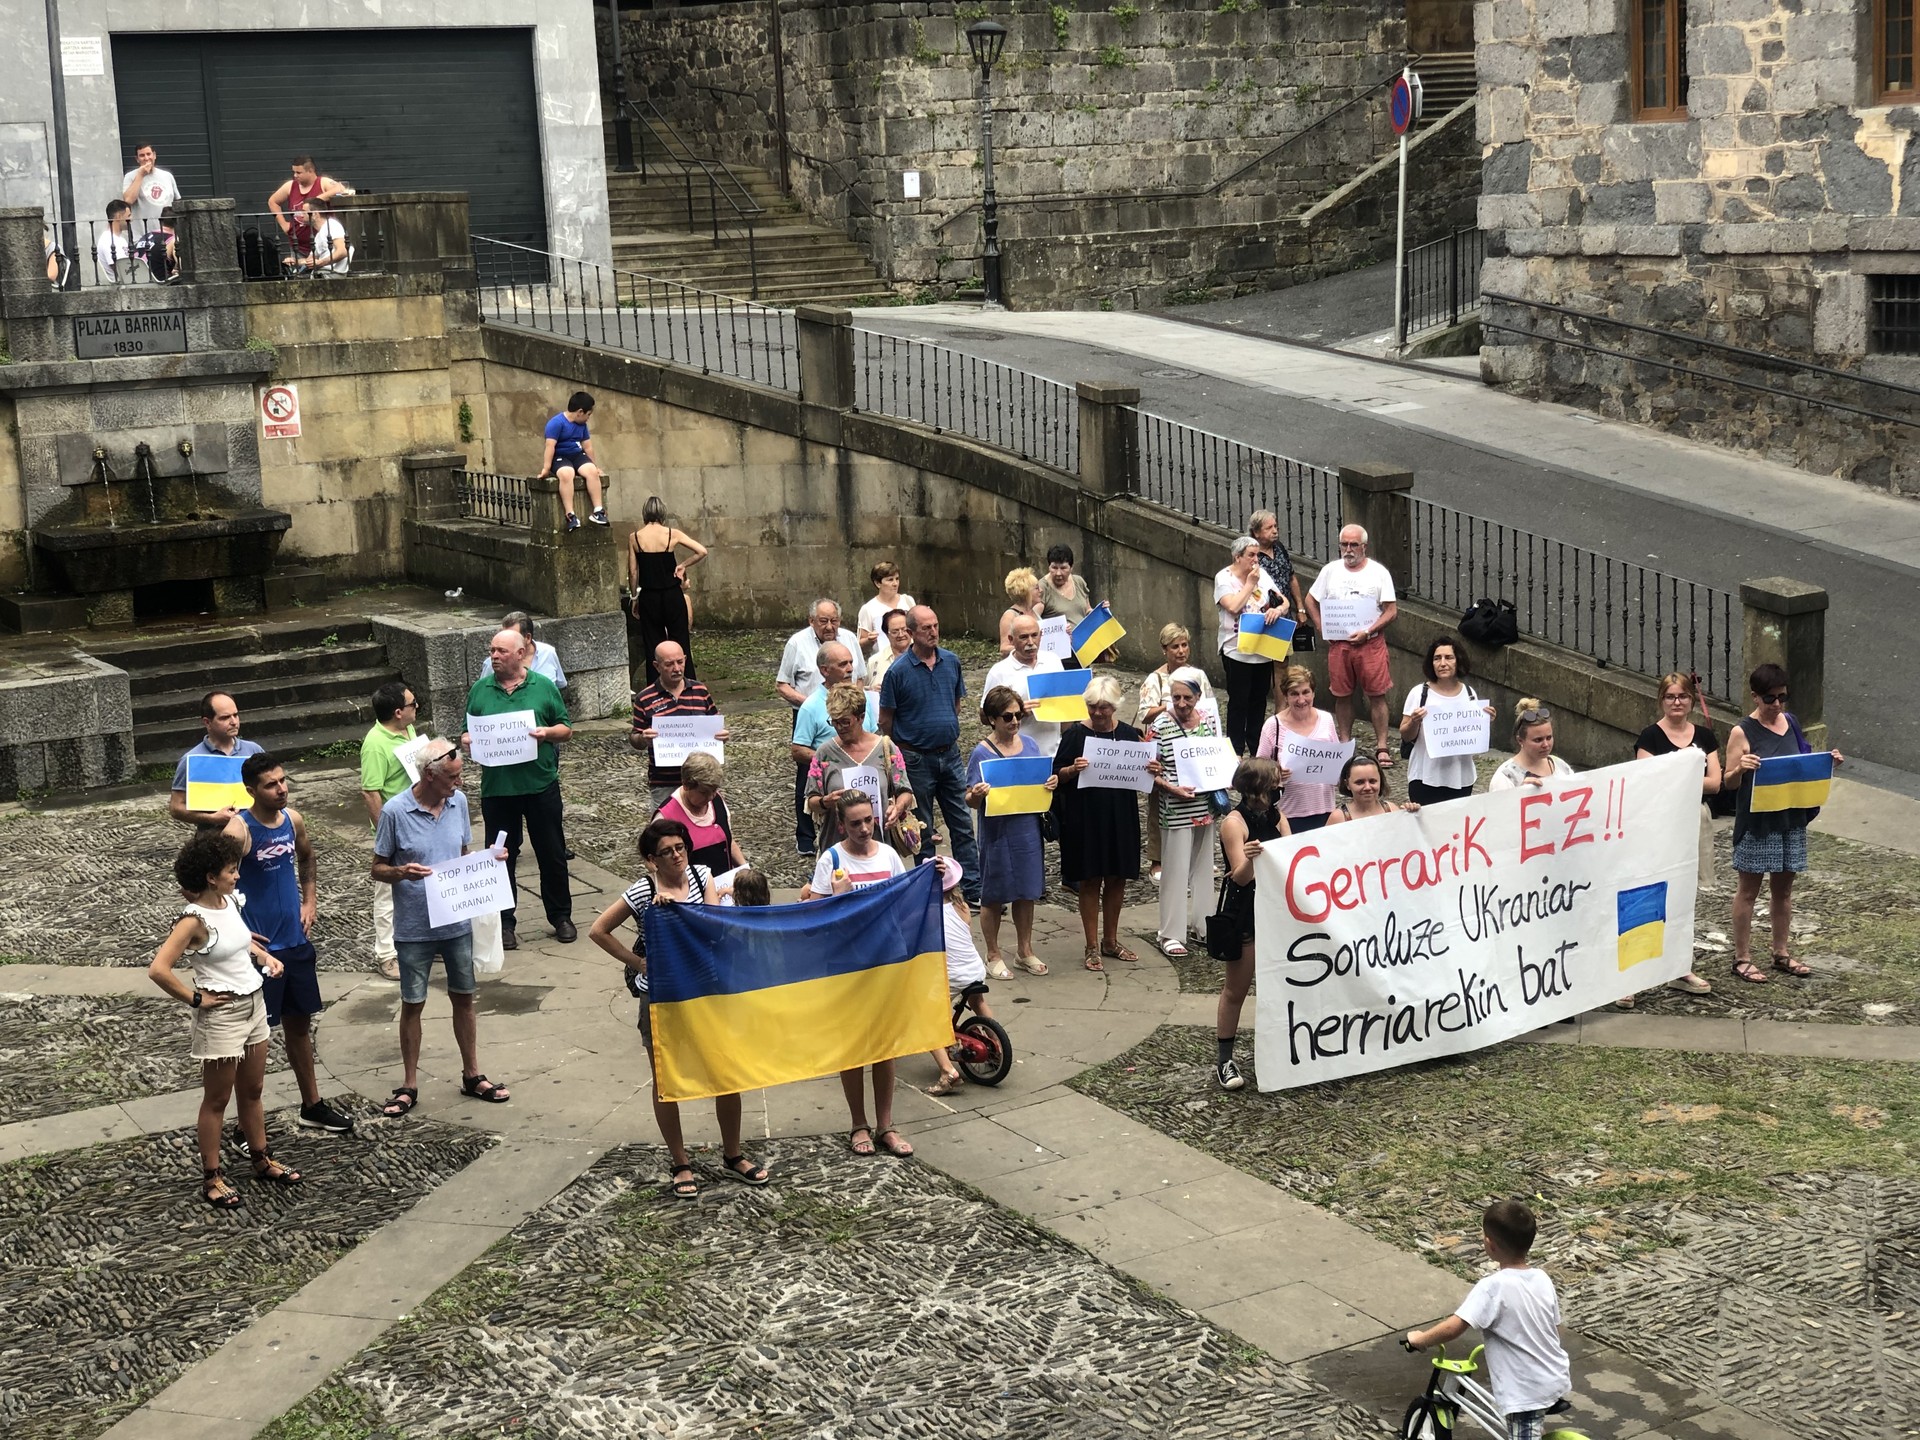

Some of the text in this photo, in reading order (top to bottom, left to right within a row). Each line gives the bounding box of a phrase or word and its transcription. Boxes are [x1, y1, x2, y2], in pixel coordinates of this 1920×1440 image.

[79, 315, 181, 337] PLAZA BARRIXA
[113, 340, 143, 353] 1830
[1040, 624, 1064, 637] ERRARIK
[1432, 709, 1484, 722] STOP PUTIN,
[473, 720, 529, 733] STOP PUTIN,
[1433, 724, 1482, 736] UTZI BAKEAN
[496, 735, 527, 745] BAKEAN
[1440, 738, 1477, 748] UKRAINIA!
[483, 748, 523, 759] UKRAINIA!
[1096, 747, 1120, 757] STOP
[1287, 743, 1344, 760] GERRARIK
[1093, 762, 1148, 772] UTZI BAKEAN
[1305, 765, 1324, 774] EZ!
[1098, 774, 1139, 783] UKRAINIA!
[1520, 776, 1625, 865] EZ!!
[437, 859, 498, 882] STOP PUTIN,
[440, 876, 498, 899] UTZI BAKEAN
[451, 893, 494, 912] UKRAINIA!
[1285, 911, 1450, 987] Soraluze
[1517, 939, 1579, 1006] bat
